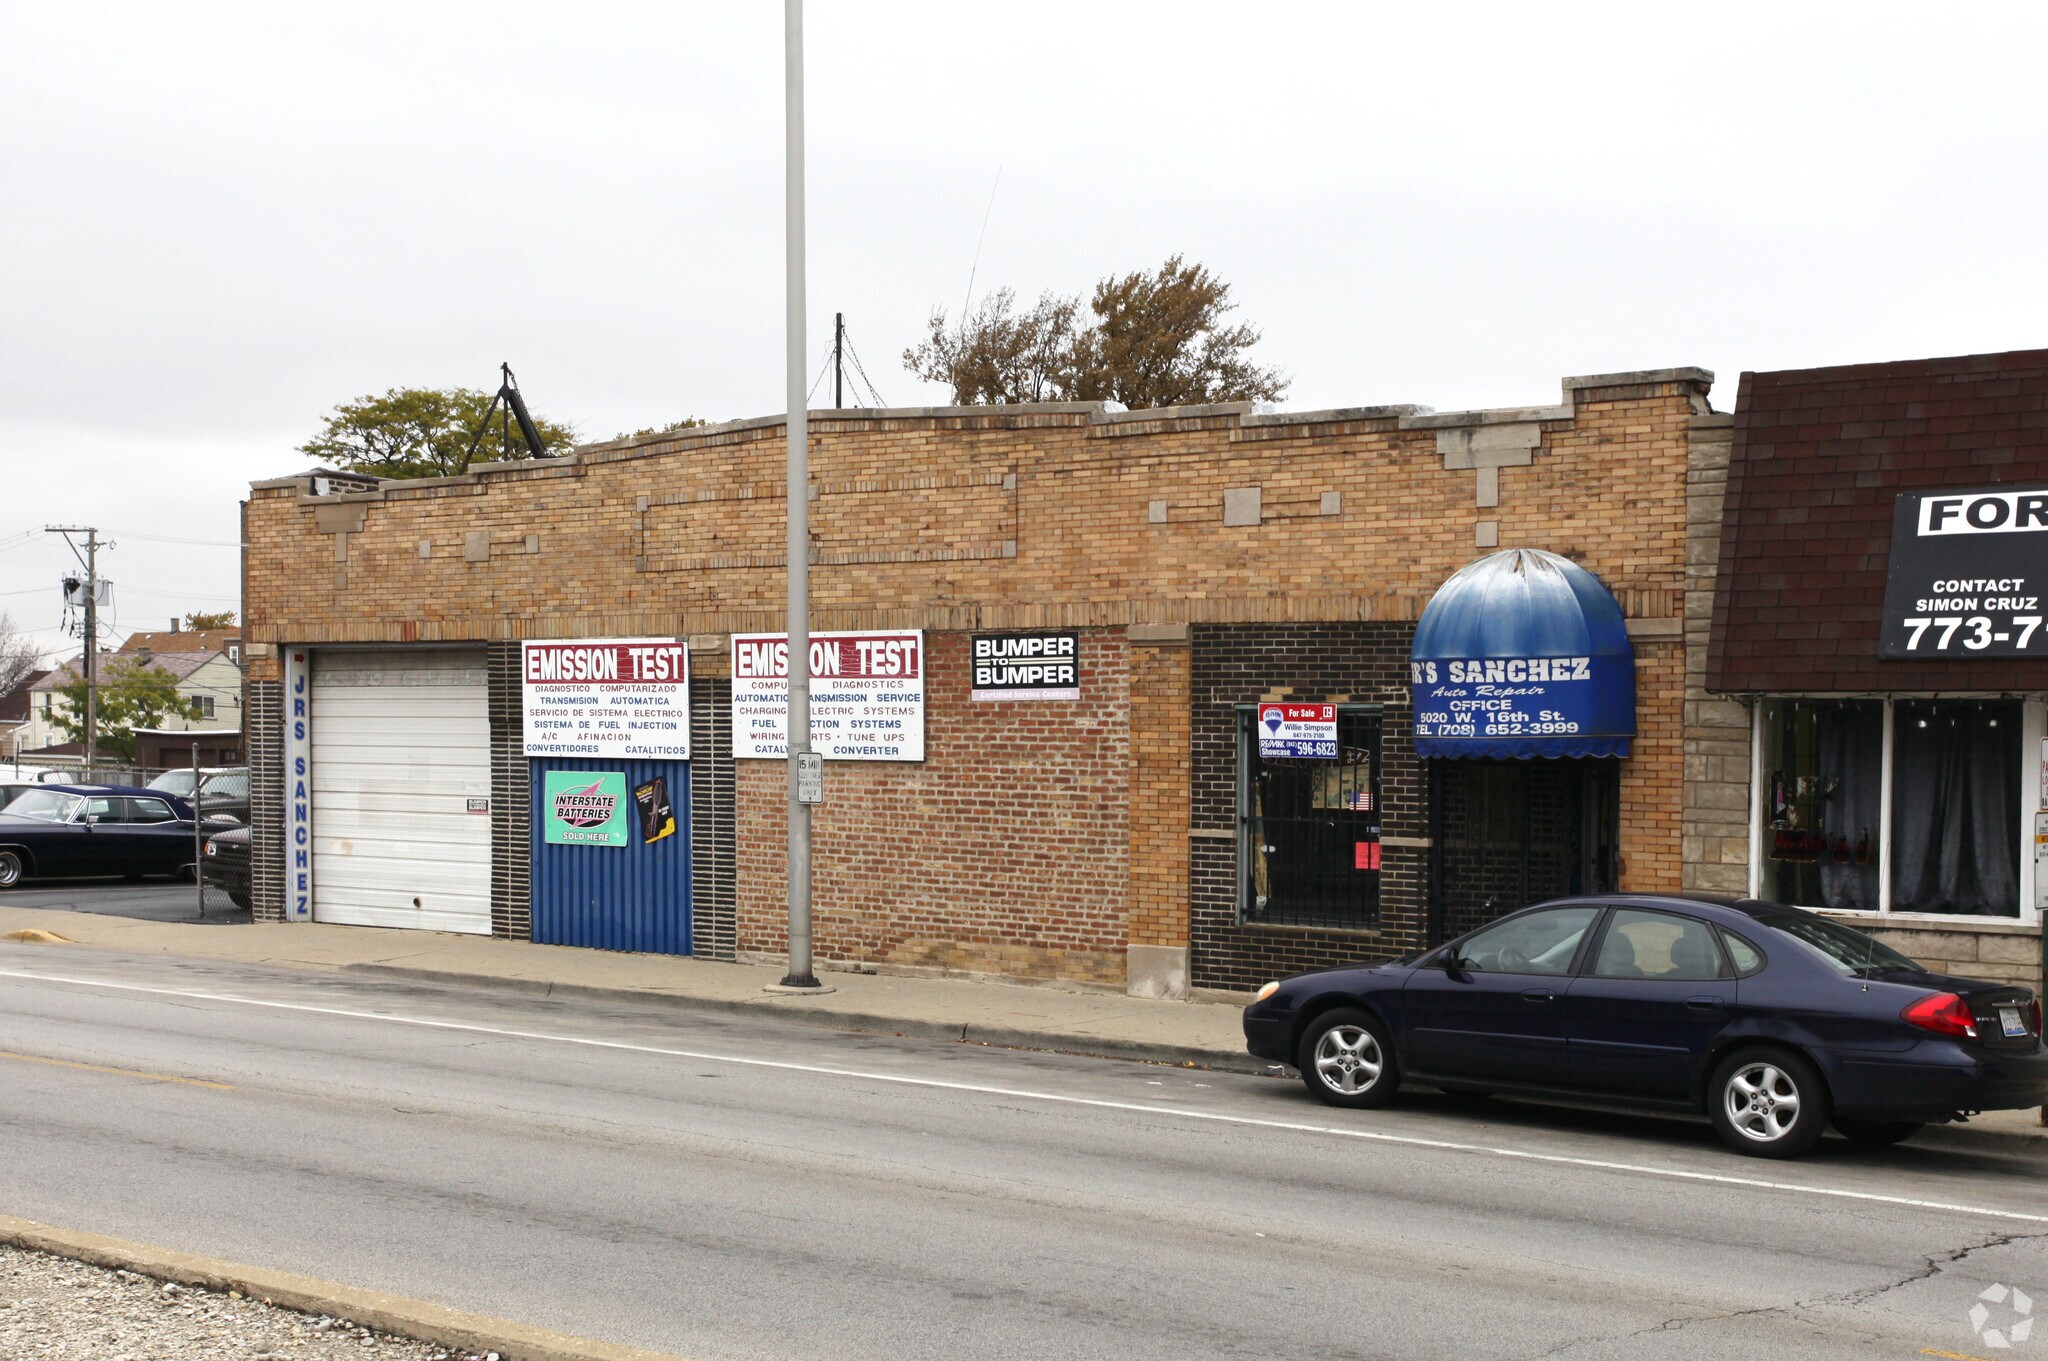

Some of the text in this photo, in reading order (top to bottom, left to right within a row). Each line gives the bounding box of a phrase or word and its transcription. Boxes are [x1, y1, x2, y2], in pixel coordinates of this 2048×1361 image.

[1929, 495, 2048, 531] FOR
[1933, 579, 2024, 593] CONTACT
[1916, 597, 2038, 612] SIMON CRUZ
[1904, 616, 2048, 650] 773-7
[976, 638, 1074, 657] BUMPER
[738, 640, 916, 676] EMISON TEST
[990, 658, 1008, 666] TO
[528, 647, 682, 680] EMISSION TEST
[976, 666, 1074, 684] BUMPER
[1450, 657, 1590, 684] SANCHEZ
[535, 684, 676, 693] DIAGNOSTICO COMPUTARIZADO
[832, 680, 904, 688] DIAGNOSTICS
[1431, 685, 1546, 698] Auto Repair
[540, 696, 670, 705] TRANSMISION AUTOMATICA
[809, 694, 867, 702] ANSMISSION
[876, 694, 920, 702] SERVICE
[294, 674, 306, 741] JRS
[864, 706, 915, 714] SYSTEMS
[1450, 700, 1512, 710] OFFICE
[589, 709, 628, 717] SISTEMA
[1289, 708, 1299, 717] For
[1301, 709, 1315, 717] Sale
[1420, 710, 1565, 723] 5020 W. 16th St.
[579, 721, 590, 729] DE
[599, 721, 620, 729] FUEL
[628, 722, 677, 730] INJECTION
[752, 720, 776, 728] FUEL
[850, 720, 902, 728] SYSTEMS
[1304, 724, 1332, 732] Simpson
[1416, 722, 1578, 737] TEL. (708) 652-3999
[542, 732, 558, 741] A/C
[750, 732, 904, 742] WIRING RTS TUNE UPS
[527, 744, 686, 754] CONVERTIDORES CATALITICOS
[834, 746, 899, 755] CONVERTER
[1262, 748, 1290, 756] Showcase
[1298, 742, 1336, 756] 596-6823
[556, 796, 614, 806] INTERSTATE
[558, 808, 610, 818] BATTERIES
[294, 756, 308, 916] SANCHEZ
[563, 832, 610, 841] SOLD HERE
